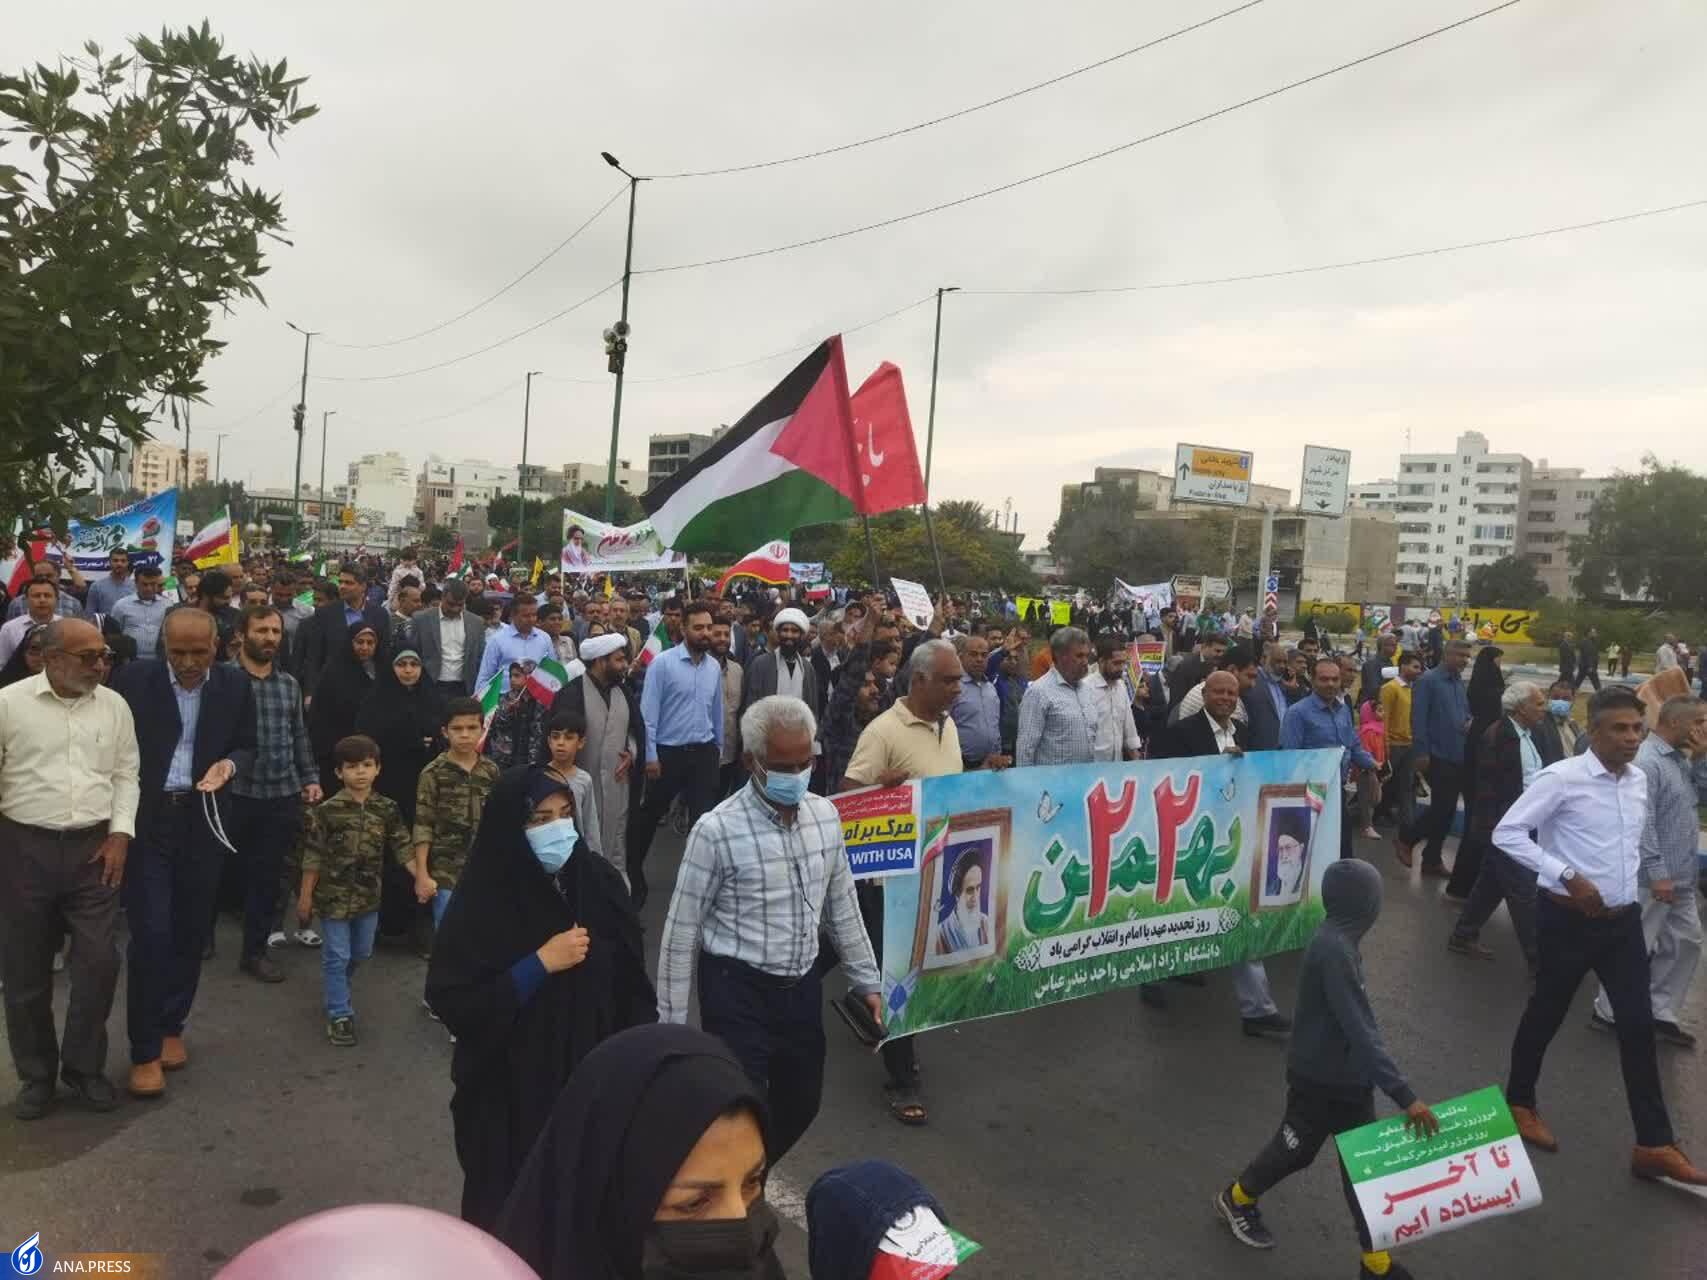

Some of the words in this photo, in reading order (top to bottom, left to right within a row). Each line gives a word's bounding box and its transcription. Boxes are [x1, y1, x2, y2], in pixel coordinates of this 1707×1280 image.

[860, 825, 877, 841] بر
[876, 818, 914, 838] مرگ
[851, 849, 884, 865] WITH
[887, 847, 913, 862] USA
[1023, 815, 1242, 935] بهمن
[1124, 925, 1143, 945] امام
[1143, 924, 1151, 941] با
[1150, 923, 1167, 938] عهد
[1167, 916, 1195, 936] تجدید
[1195, 918, 1210, 933] روز
[1063, 935, 1092, 958] گرامی
[1092, 928, 1119, 950] انقلاب
[1118, 935, 1124, 947] و
[1049, 940, 1062, 959] باد
[1158, 945, 1181, 970] آزاد
[1183, 943, 1220, 963] دانشگاه
[1089, 961, 1117, 982] واحد
[1119, 952, 1156, 980] اسلامی
[1489, 1144, 1511, 1169] تا
[1381, 1151, 1479, 1216] آخر
[1439, 1176, 1521, 1223] ایستاده
[1394, 1205, 1430, 1243] ایم
